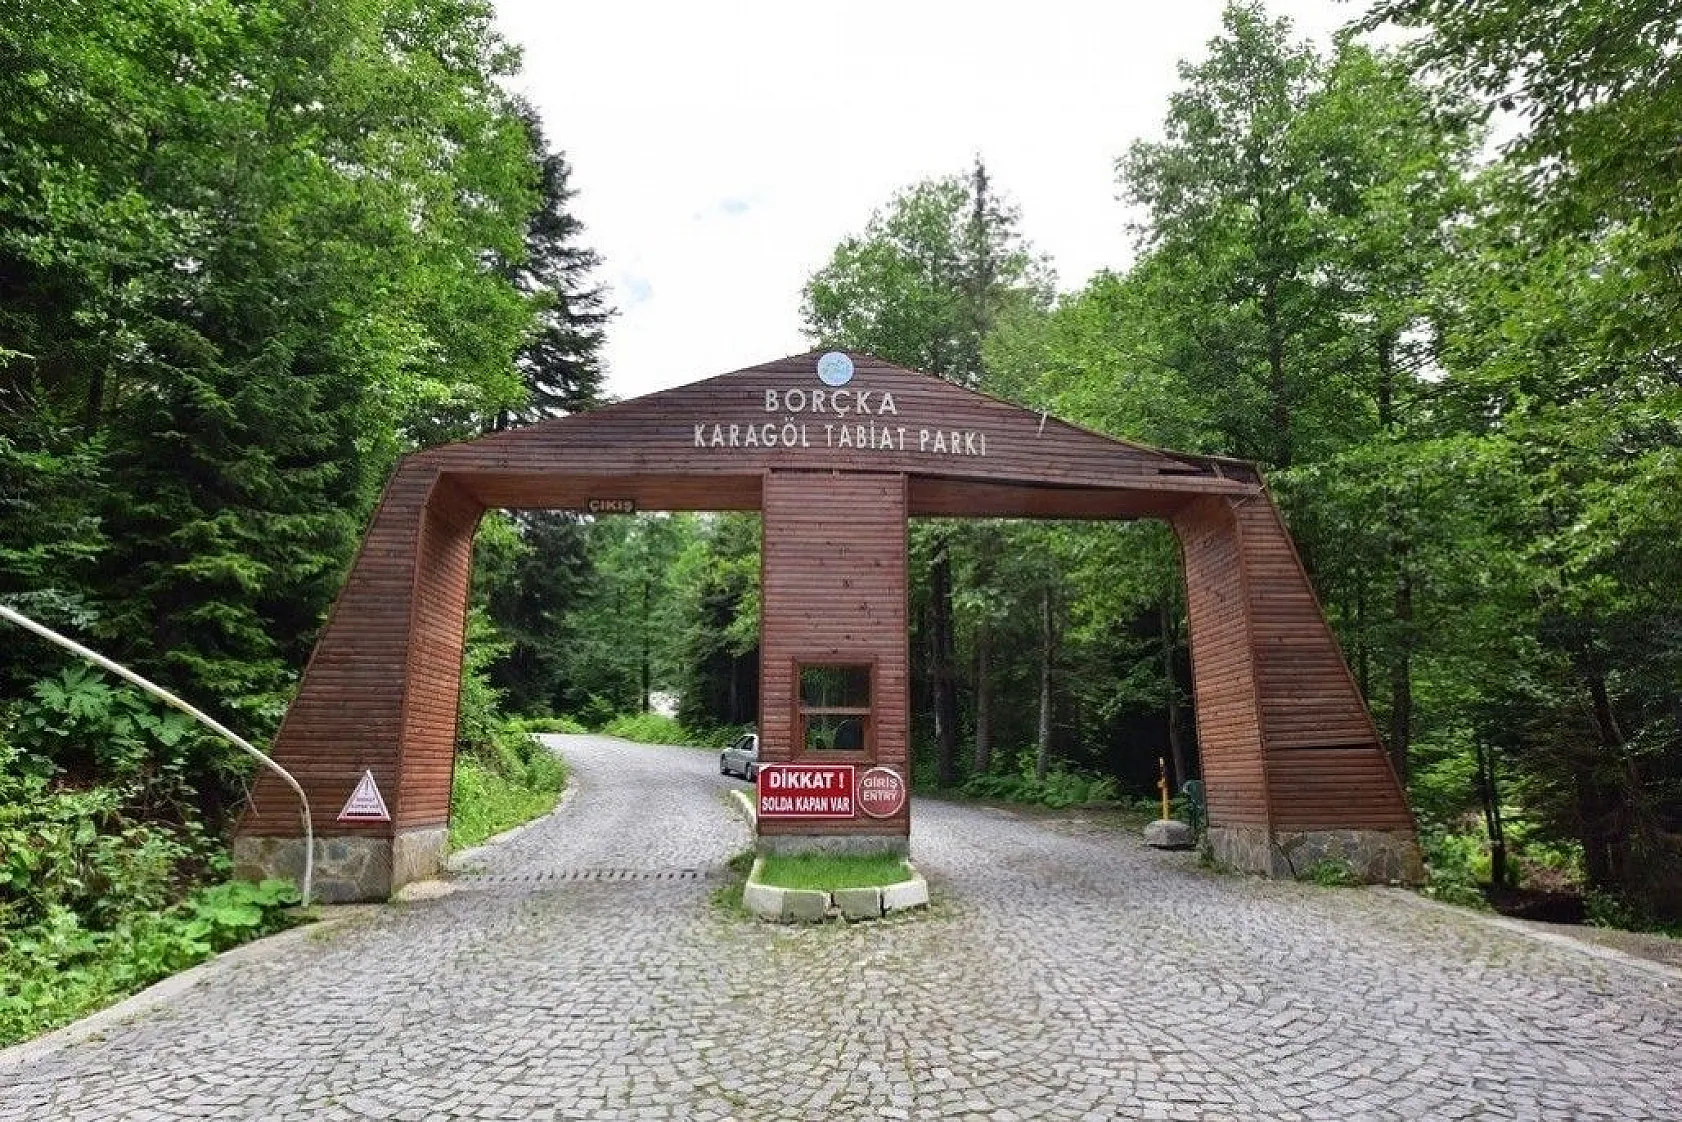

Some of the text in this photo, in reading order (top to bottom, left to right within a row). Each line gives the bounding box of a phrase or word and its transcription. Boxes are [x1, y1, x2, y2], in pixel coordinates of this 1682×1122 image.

[765, 389, 898, 417] BORÇKA
[694, 417, 987, 456] KARAGÖL TABİAT PARKI
[769, 768, 845, 789] DİKKAT !
[863, 776, 898, 789] GİRİŞ
[762, 796, 850, 811] SOLDA KAPAN VAR
[863, 790, 897, 802] ENTRY
